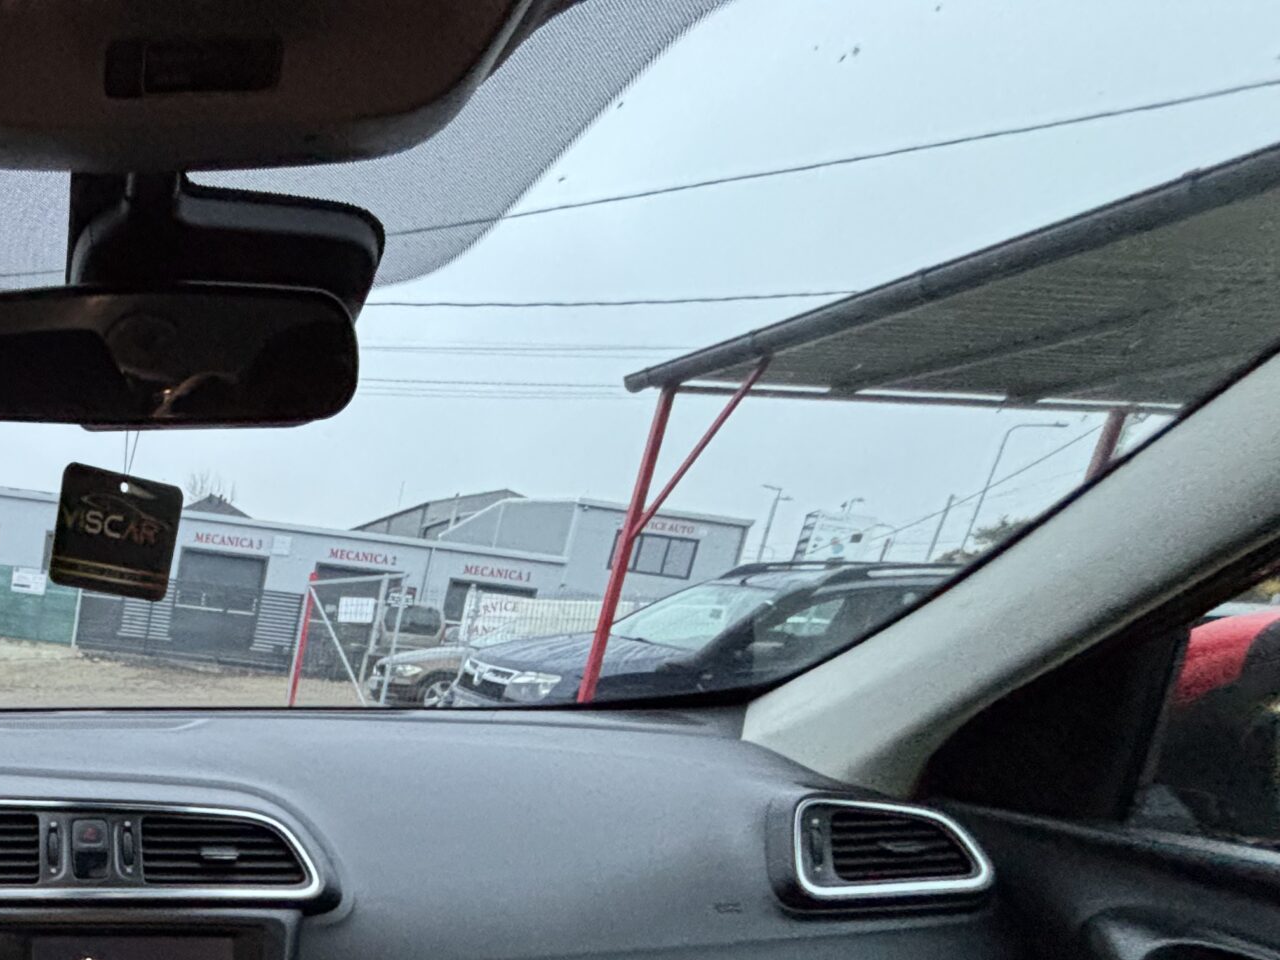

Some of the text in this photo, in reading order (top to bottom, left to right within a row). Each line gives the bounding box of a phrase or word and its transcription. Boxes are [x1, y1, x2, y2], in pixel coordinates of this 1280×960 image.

[62, 504, 161, 545] VISCAR
[667, 523, 695, 534] AUTO
[194, 532, 263, 550] MECANICA 3
[329, 548, 397, 566] MECANICA 2
[463, 565, 523, 581] MECANICA
